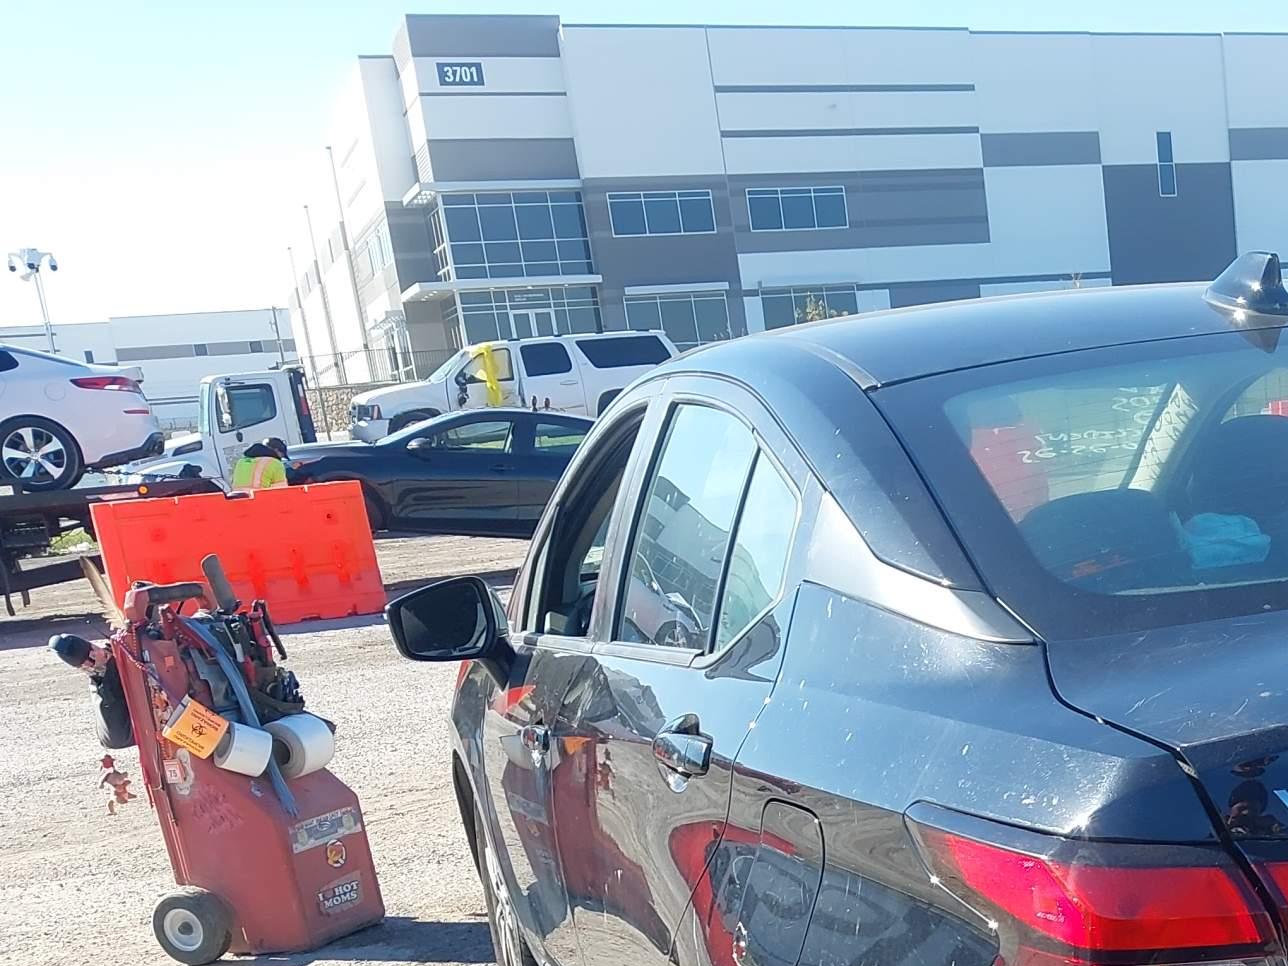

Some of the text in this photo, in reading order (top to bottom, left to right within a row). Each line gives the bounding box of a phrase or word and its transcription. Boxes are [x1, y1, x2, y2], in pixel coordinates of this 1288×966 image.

[443, 66, 478, 82] 3701
[318, 881, 359, 901] I HOT
[324, 891, 358, 909] MOMS
